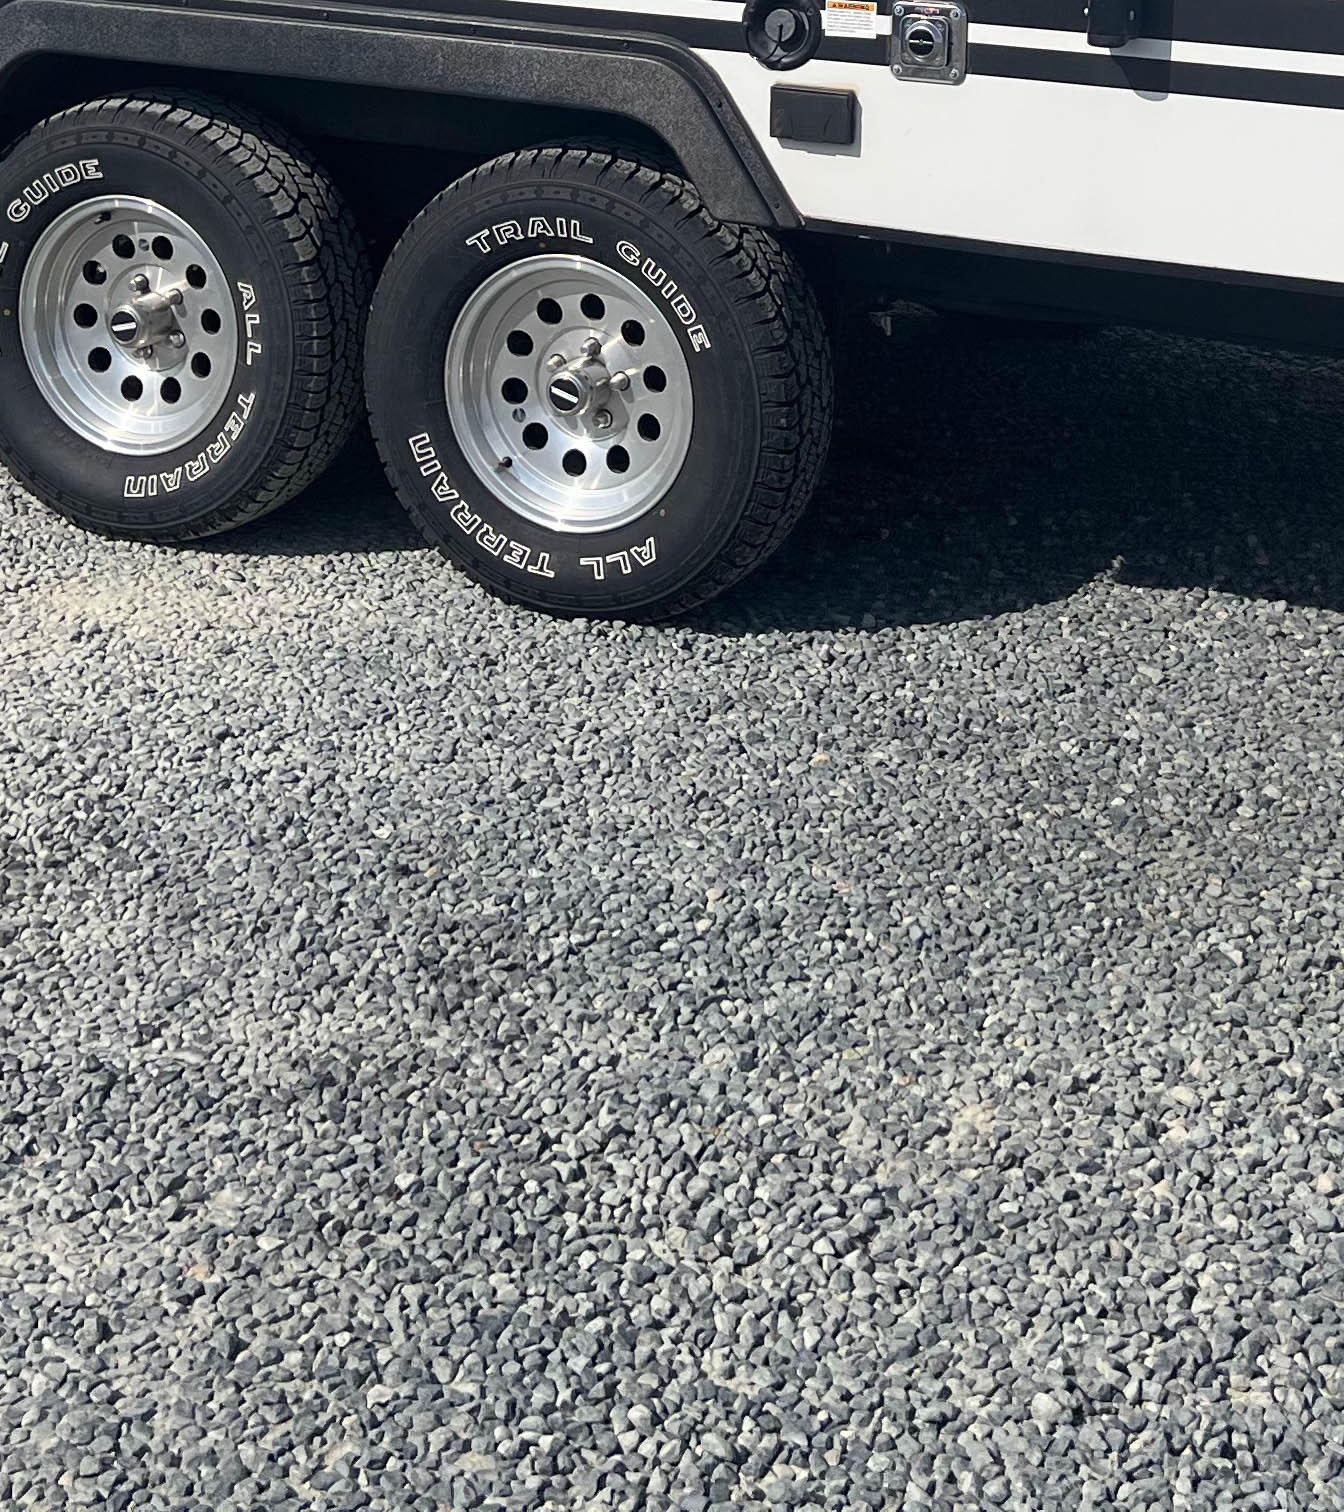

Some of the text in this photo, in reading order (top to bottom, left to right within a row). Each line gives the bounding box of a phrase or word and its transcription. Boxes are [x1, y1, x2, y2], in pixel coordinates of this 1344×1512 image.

[6, 158, 104, 223] GUIDE
[465, 216, 712, 353] TRAIL GUIDE
[123, 281, 262, 498] ALL TERRAIN
[408, 432, 658, 580] ALL TERRAIN
